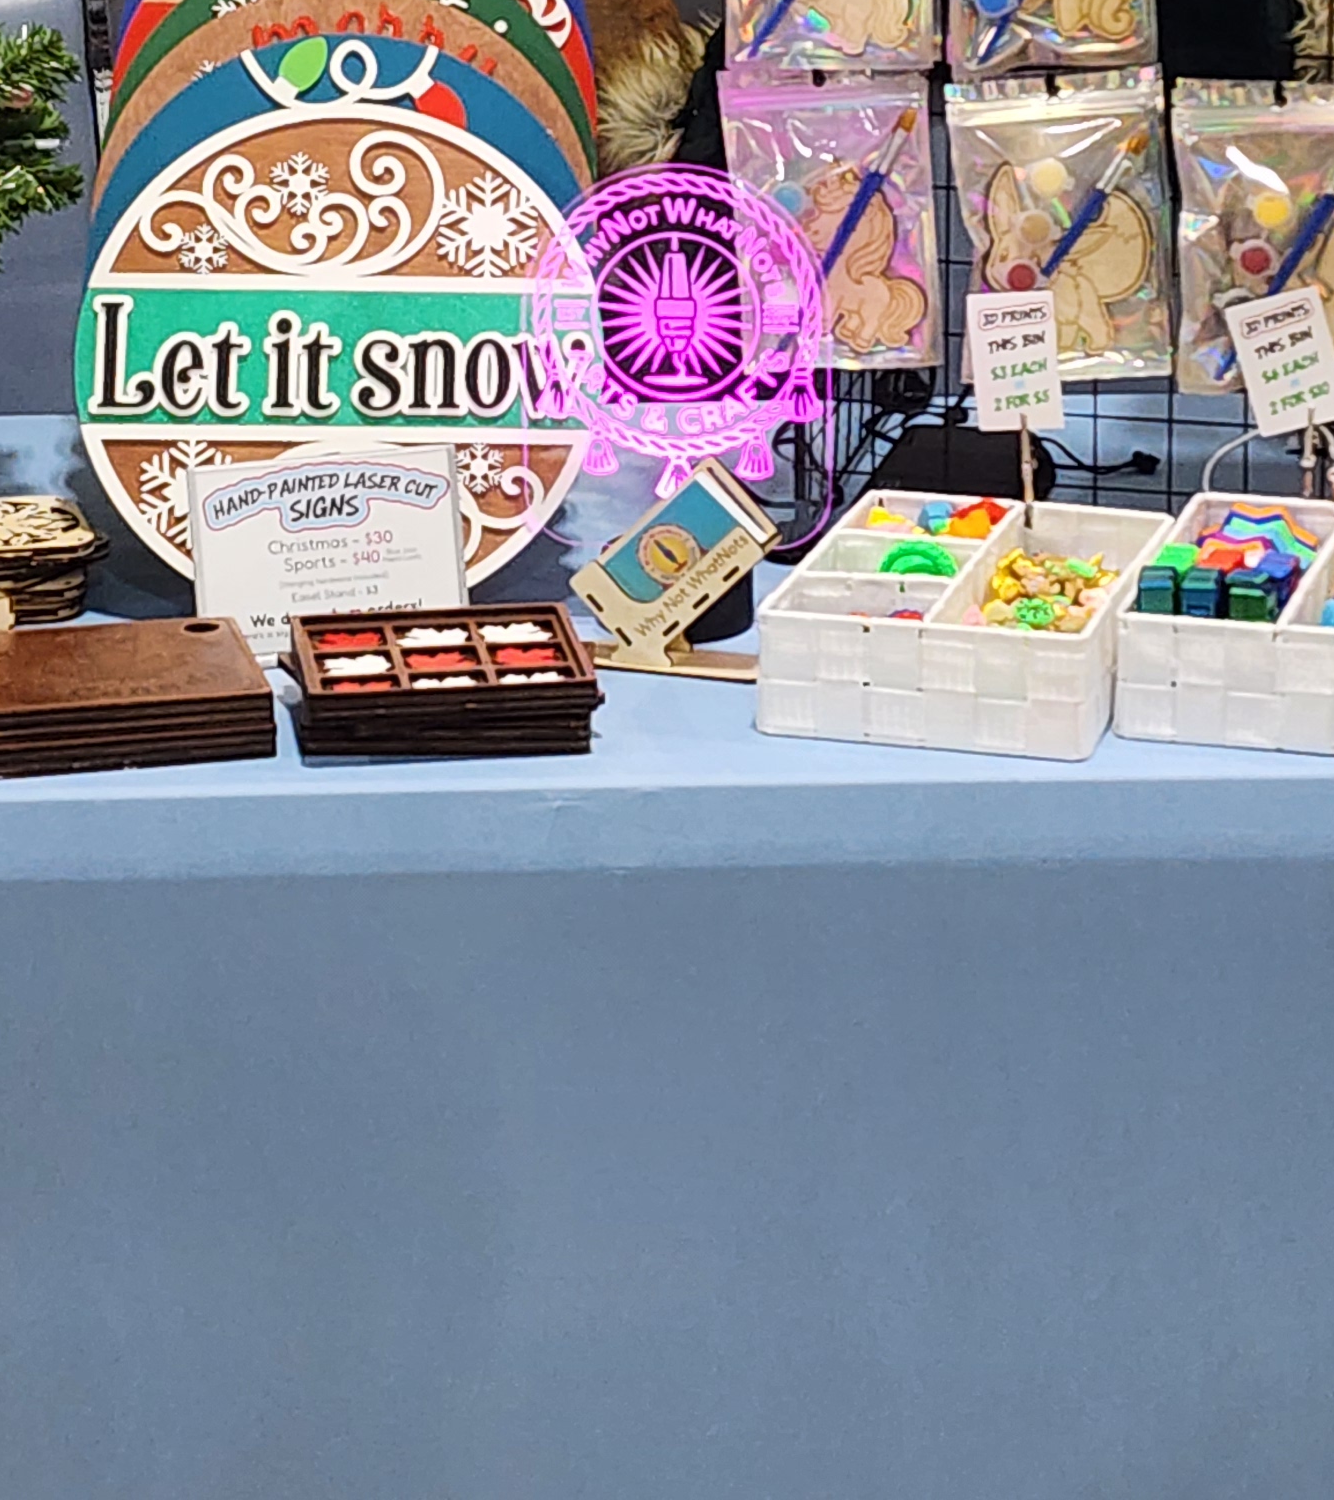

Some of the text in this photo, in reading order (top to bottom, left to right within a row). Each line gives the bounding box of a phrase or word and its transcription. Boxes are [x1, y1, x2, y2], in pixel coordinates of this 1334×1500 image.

[91, 297, 588, 412] Let it snow
[987, 330, 1046, 355] THIS BIN
[1005, 392, 1031, 411] FOR
[212, 471, 439, 520] HAND-PAINTED LASER CUT
[289, 494, 361, 522] SIGNS
[267, 535, 348, 555] Christmas
[364, 530, 394, 547] $30
[284, 555, 337, 574] Sports
[352, 549, 381, 567] $40
[633, 611, 667, 637] Why
[668, 586, 691, 613] Not
[686, 534, 750, 591] WhatNots
[249, 614, 275, 629] We
